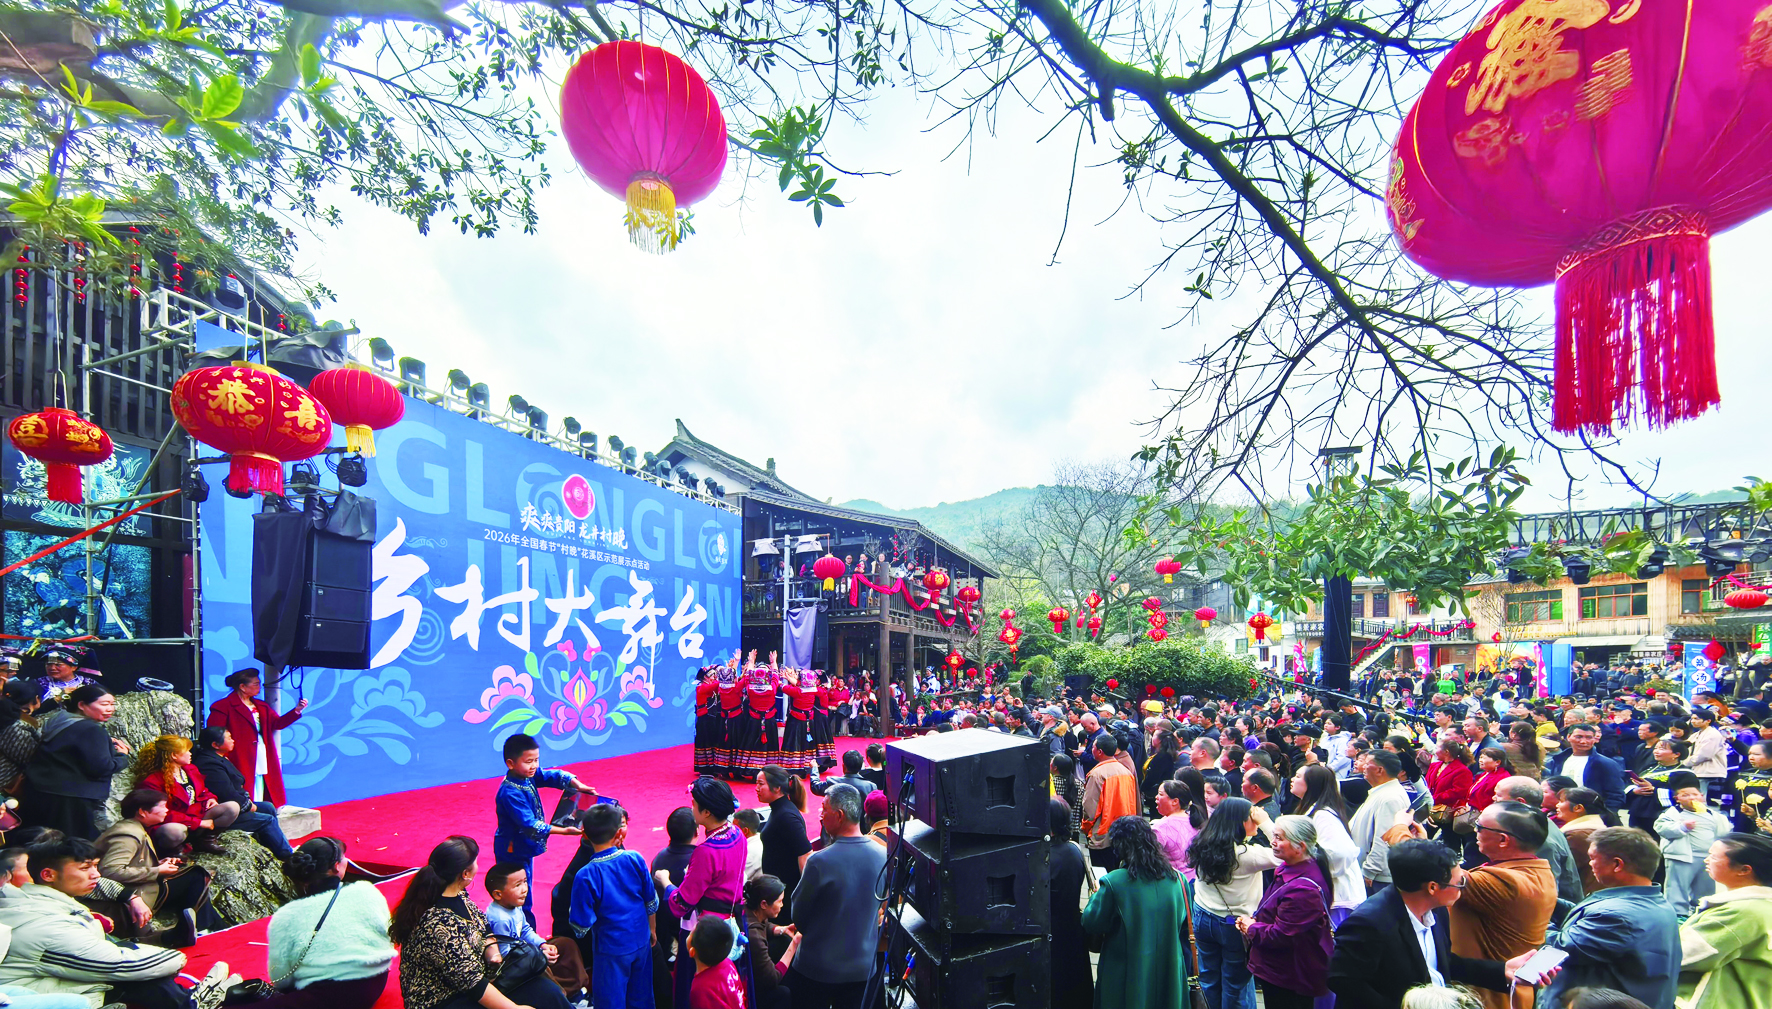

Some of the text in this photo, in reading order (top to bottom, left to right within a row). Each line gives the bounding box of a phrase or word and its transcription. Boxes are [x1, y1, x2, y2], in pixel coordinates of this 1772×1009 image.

[520, 501, 628, 550] 爽爽贵阳 龙井村晚
